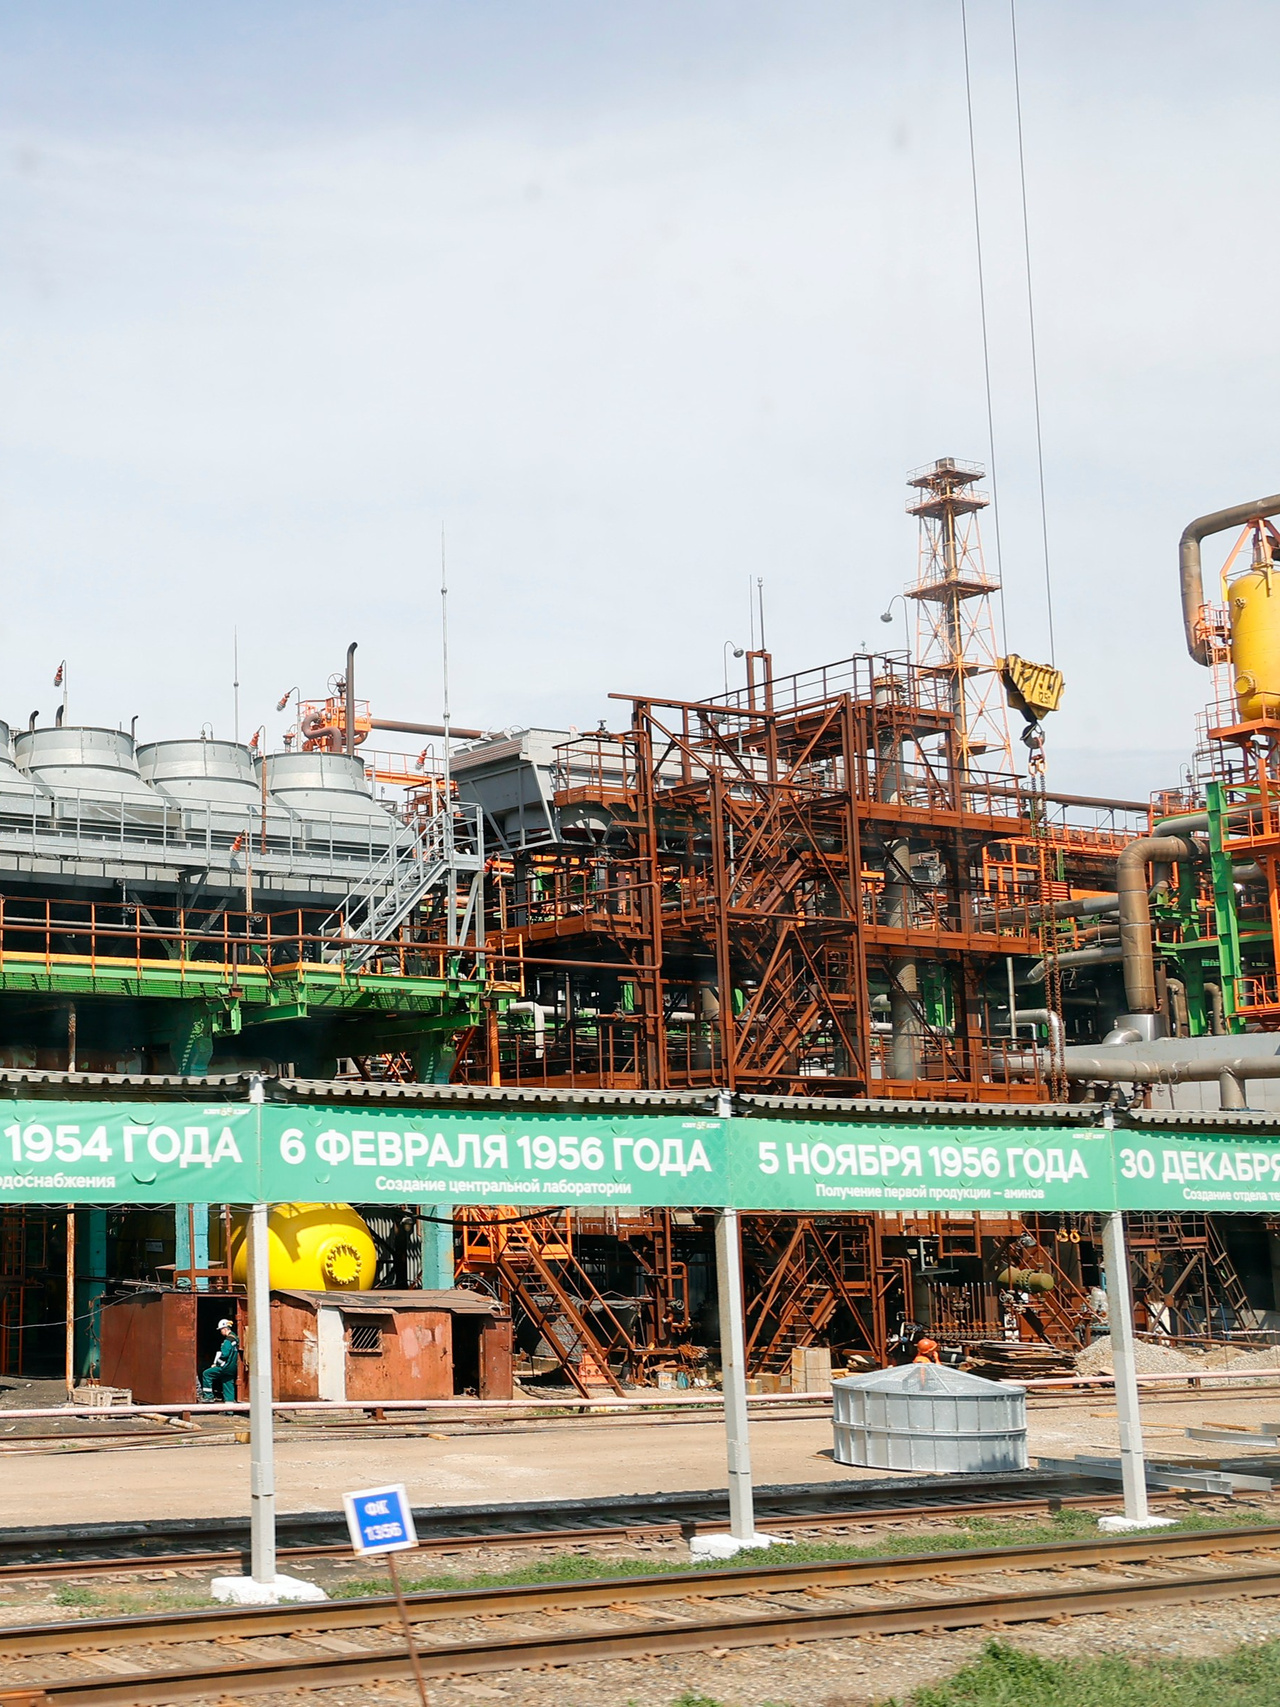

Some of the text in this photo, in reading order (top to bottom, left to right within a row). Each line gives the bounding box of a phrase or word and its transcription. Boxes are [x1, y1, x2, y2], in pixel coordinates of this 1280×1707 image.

[3, 1124, 113, 1163] 1954
[122, 1125, 243, 1169] ГОДА
[280, 1128, 712, 1177] 6 ФЕВРАЛЯ 1956 ГОДА
[758, 1141, 1089, 1183] 5 НОЯБРЯ 1956 ГОДА
[1119, 1148, 1156, 1179] 30
[375, 1175, 632, 1197] Создание центральной лаборатории
[815, 1183, 883, 1200] Получение
[883, 1184, 928, 1201] первой
[928, 1187, 992, 1201] продукции
[1003, 1188, 1045, 1200] аминов
[1183, 1187, 1232, 1202] Создание
[1232, 1190, 1268, 1203] отдела
[363, 1499, 391, 1517] ФК
[363, 1522, 403, 1541] 1356
